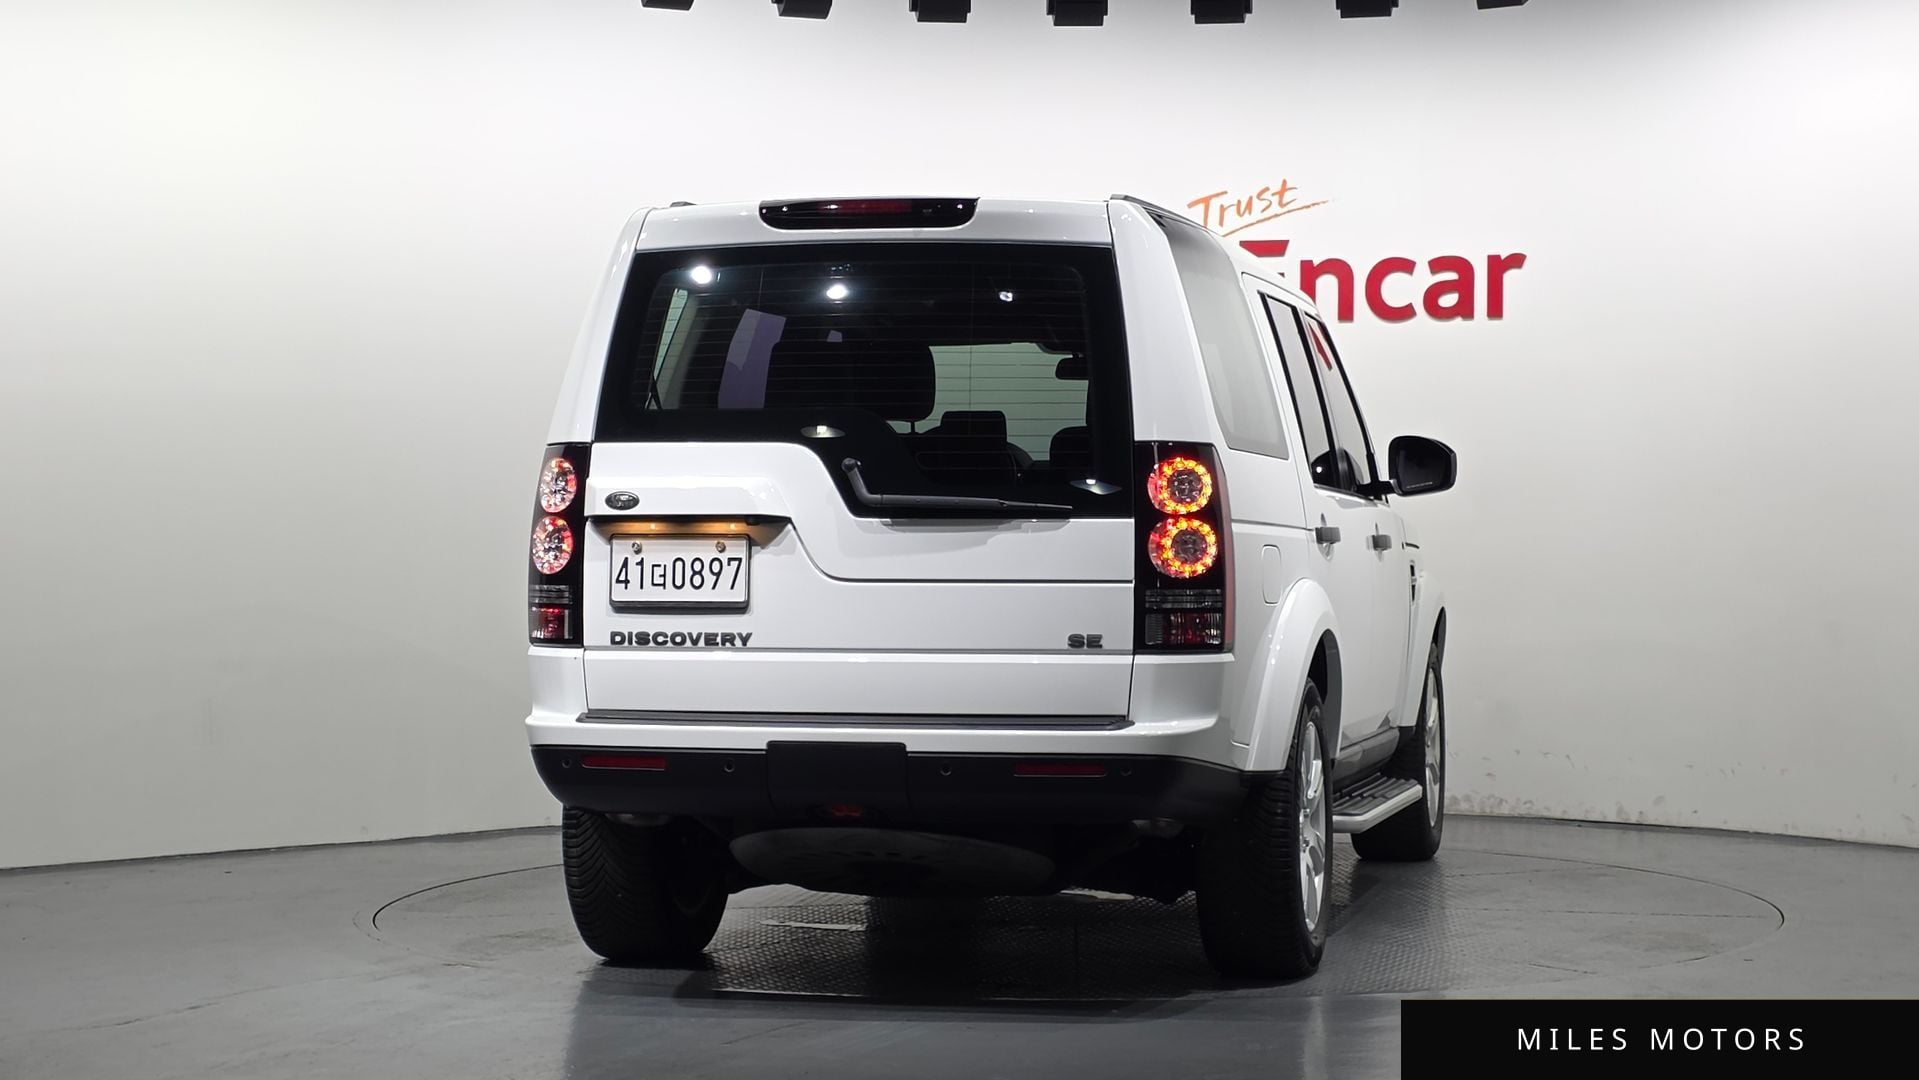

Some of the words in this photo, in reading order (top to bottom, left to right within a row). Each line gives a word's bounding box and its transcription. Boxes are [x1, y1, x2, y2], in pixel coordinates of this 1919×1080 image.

[1187, 178, 1298, 229] Trust
[615, 556, 743, 590] 41더0897
[610, 631, 753, 647] DISCOVERY
[1067, 633, 1103, 649] SE
